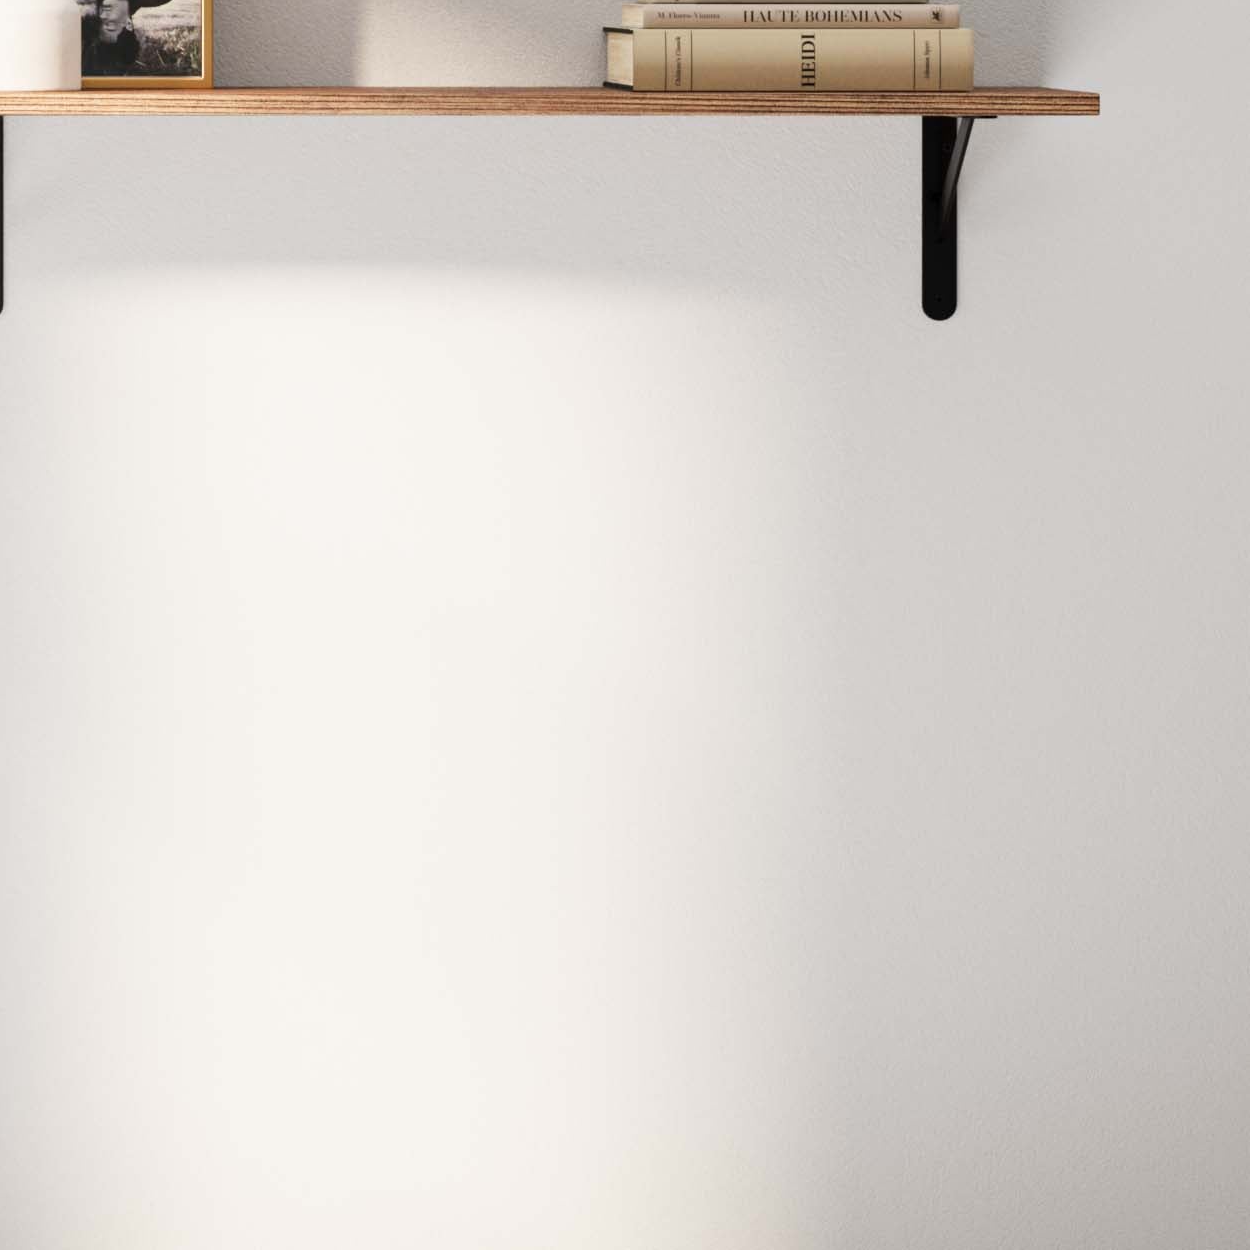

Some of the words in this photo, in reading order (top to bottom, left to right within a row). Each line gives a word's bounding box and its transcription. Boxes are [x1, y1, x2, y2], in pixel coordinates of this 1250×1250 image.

[743, 10, 800, 23] HAUTE
[805, 10, 903, 23] BOHEMIANS
[801, 34, 816, 87] HEIDI
